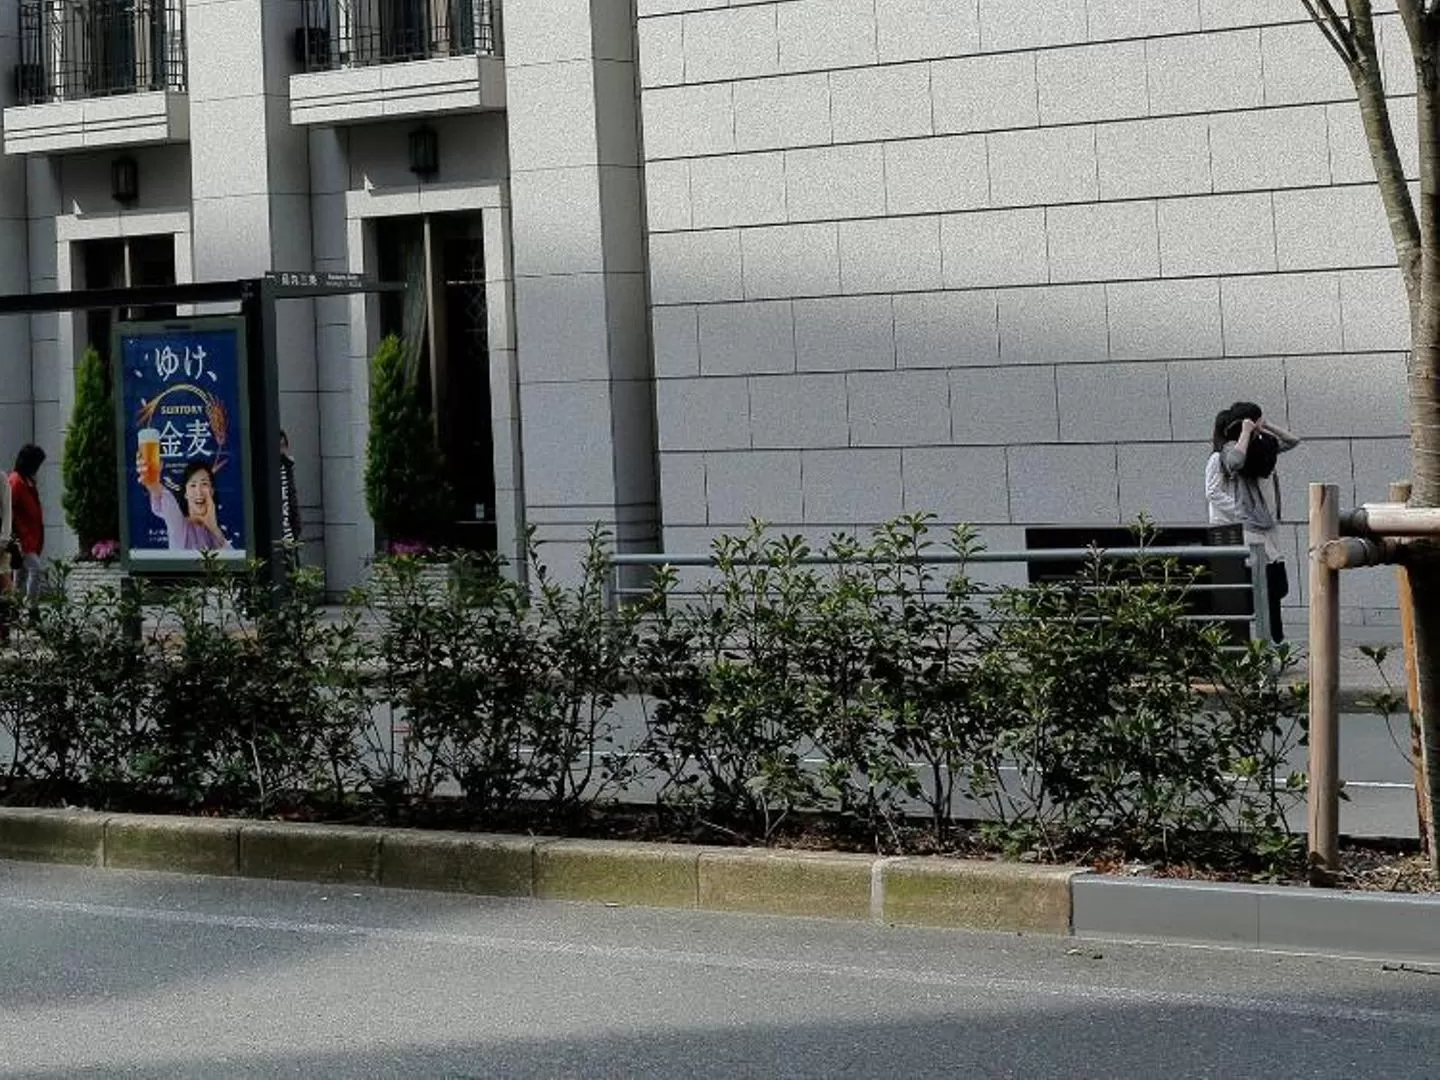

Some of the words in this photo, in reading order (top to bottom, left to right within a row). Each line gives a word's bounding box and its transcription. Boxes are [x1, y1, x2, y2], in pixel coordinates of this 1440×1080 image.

[154, 344, 219, 382] ゆけ、
[160, 405, 203, 415] SUNTORY
[159, 419, 213, 458] 金麦
